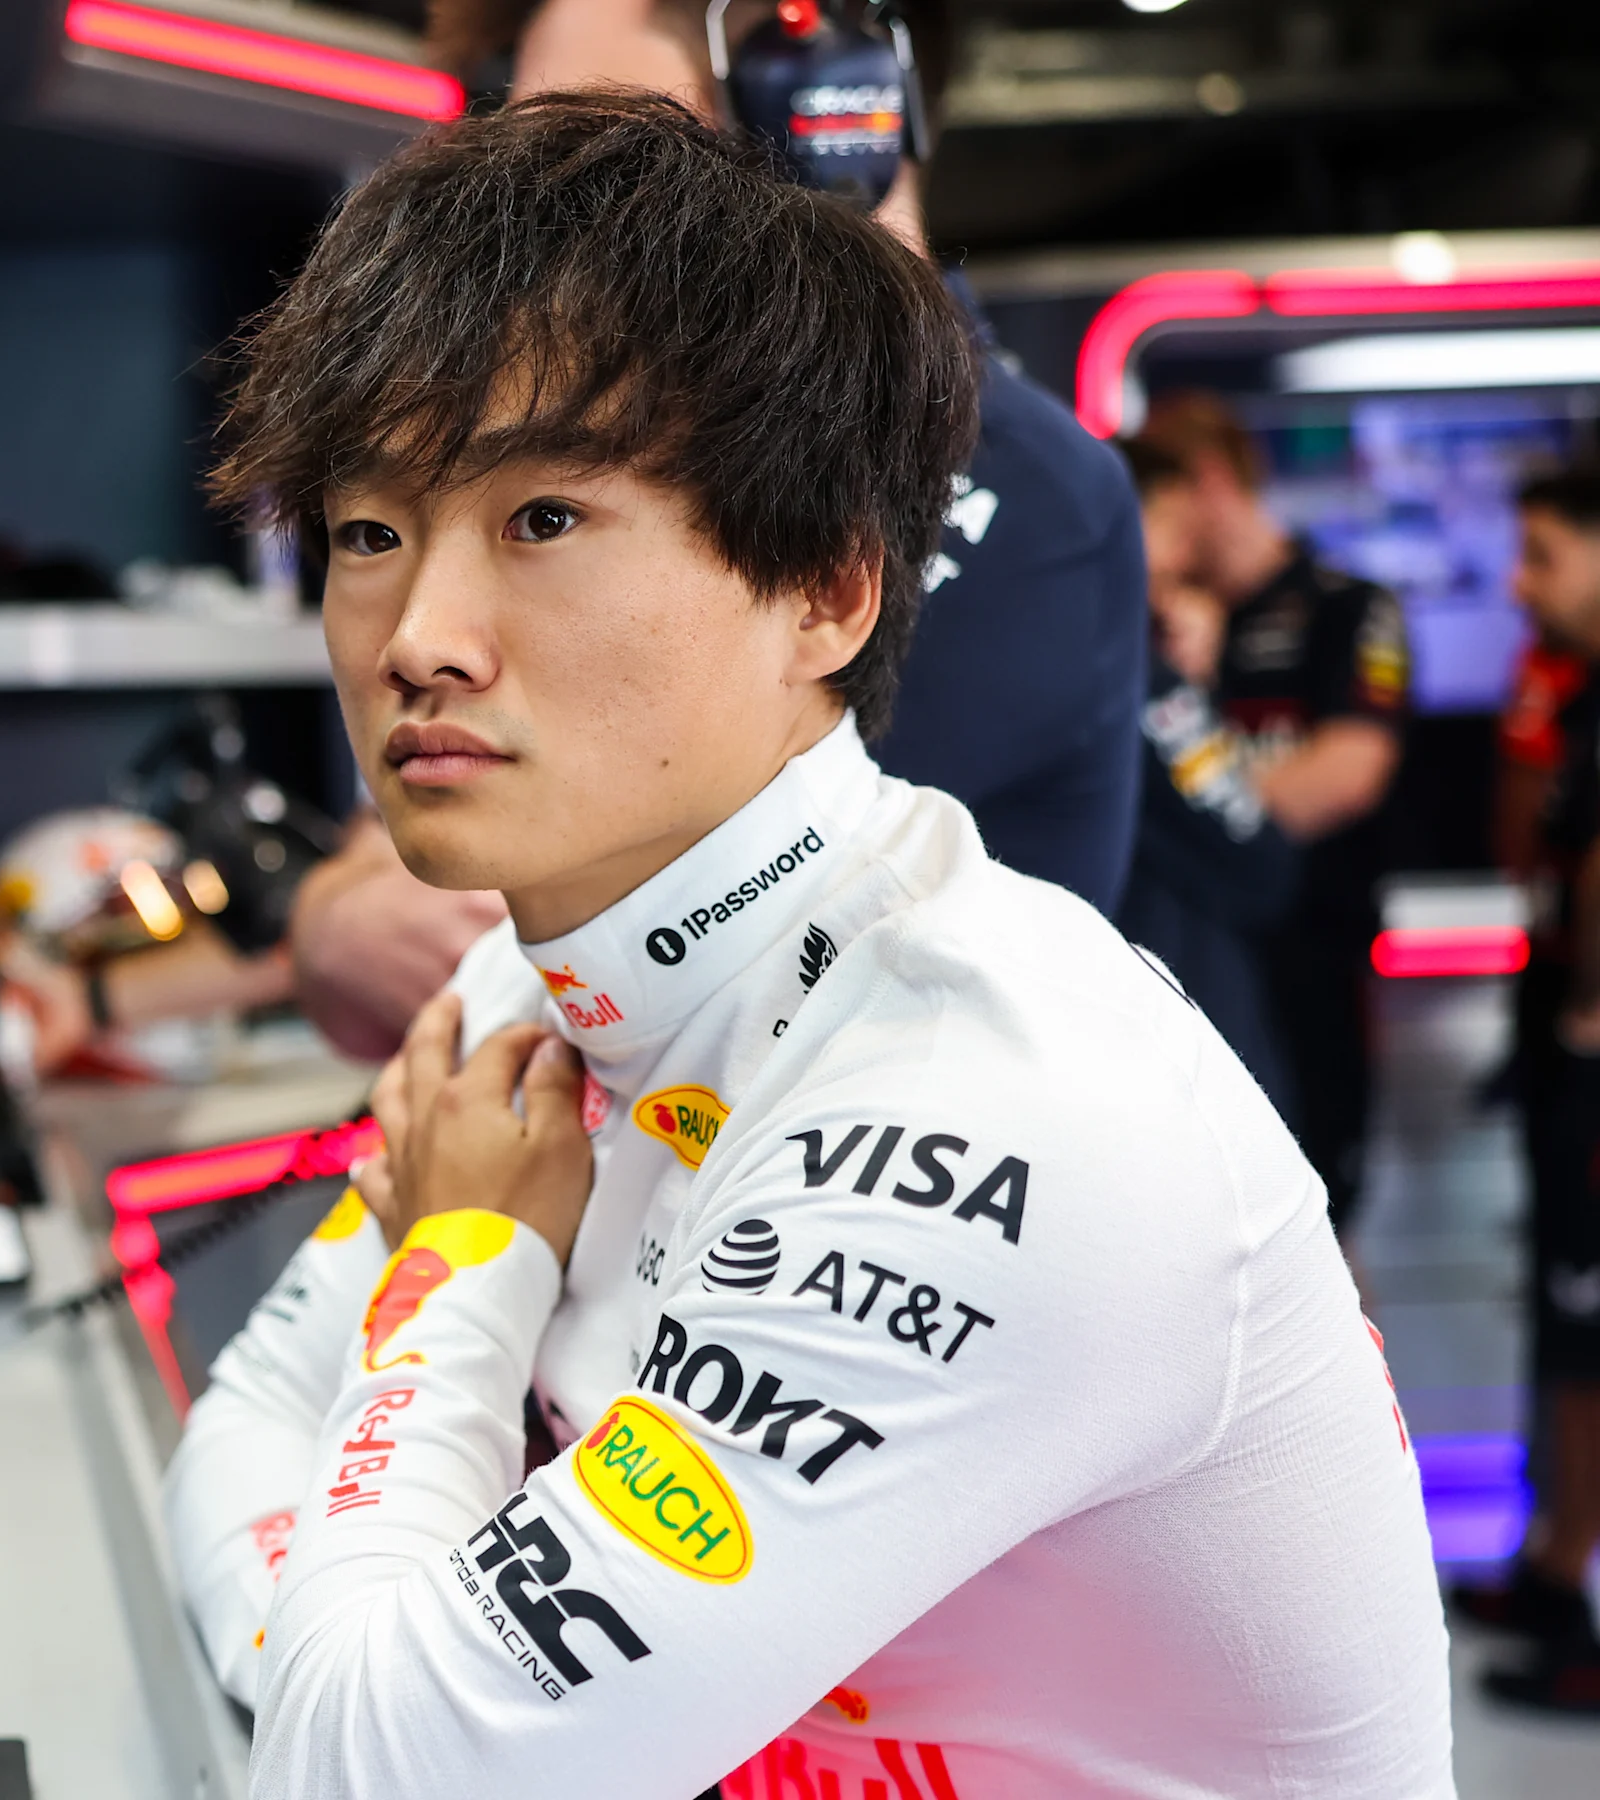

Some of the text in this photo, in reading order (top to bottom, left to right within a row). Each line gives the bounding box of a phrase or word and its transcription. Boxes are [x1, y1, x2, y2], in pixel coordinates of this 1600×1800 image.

[681, 825, 826, 942] 1Password
[565, 992, 625, 1030] Bull
[785, 1124, 1030, 1246] VISA
[792, 1250, 996, 1364] AT&T
[325, 1388, 417, 1518] Red Bull
[637, 1312, 887, 1486] ROKT
[599, 1423, 731, 1561] RAUCH
[448, 1547, 567, 1702] onda RACING
[467, 1491, 653, 1687] HRC
